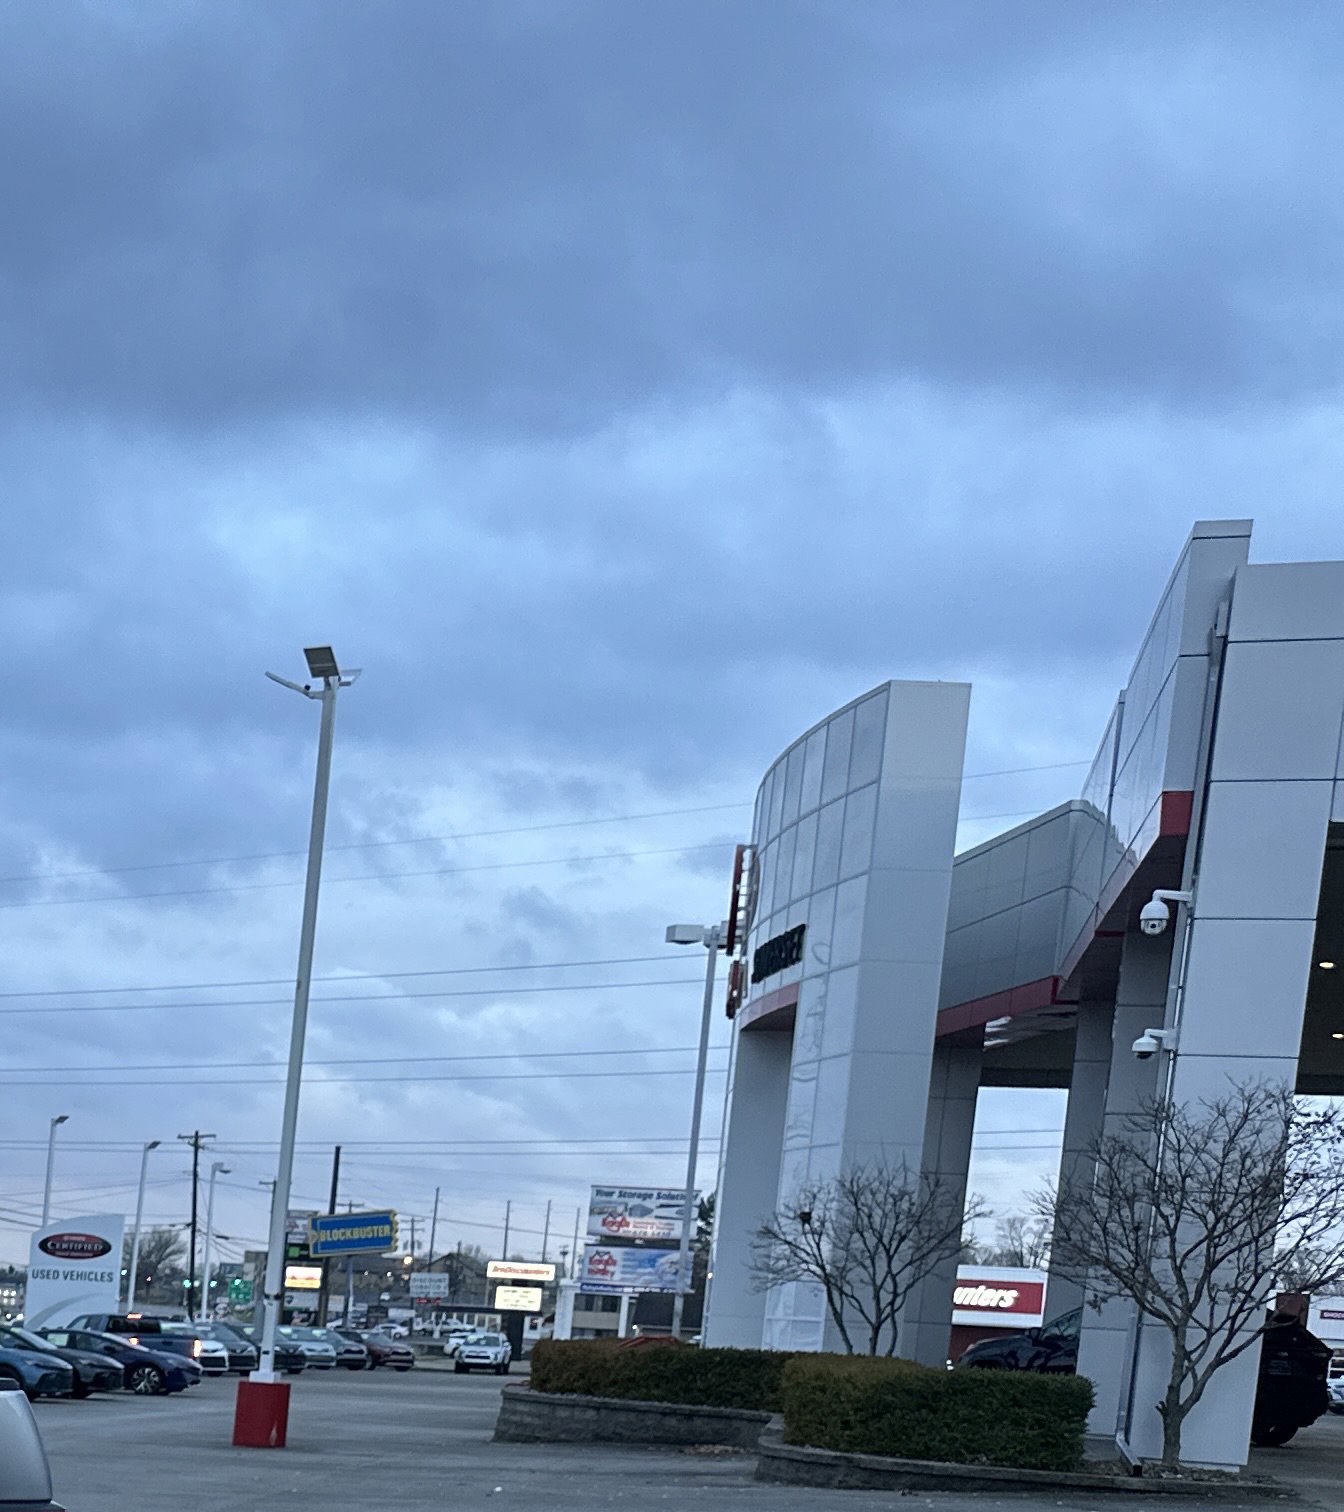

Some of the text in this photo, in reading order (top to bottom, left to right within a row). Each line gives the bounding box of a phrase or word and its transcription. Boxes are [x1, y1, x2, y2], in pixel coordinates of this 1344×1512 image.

[617, 1190, 654, 1202] Storage
[319, 1225, 392, 1242] BLOCKBUSTER
[32, 1268, 114, 1283] USED VEHICLES
